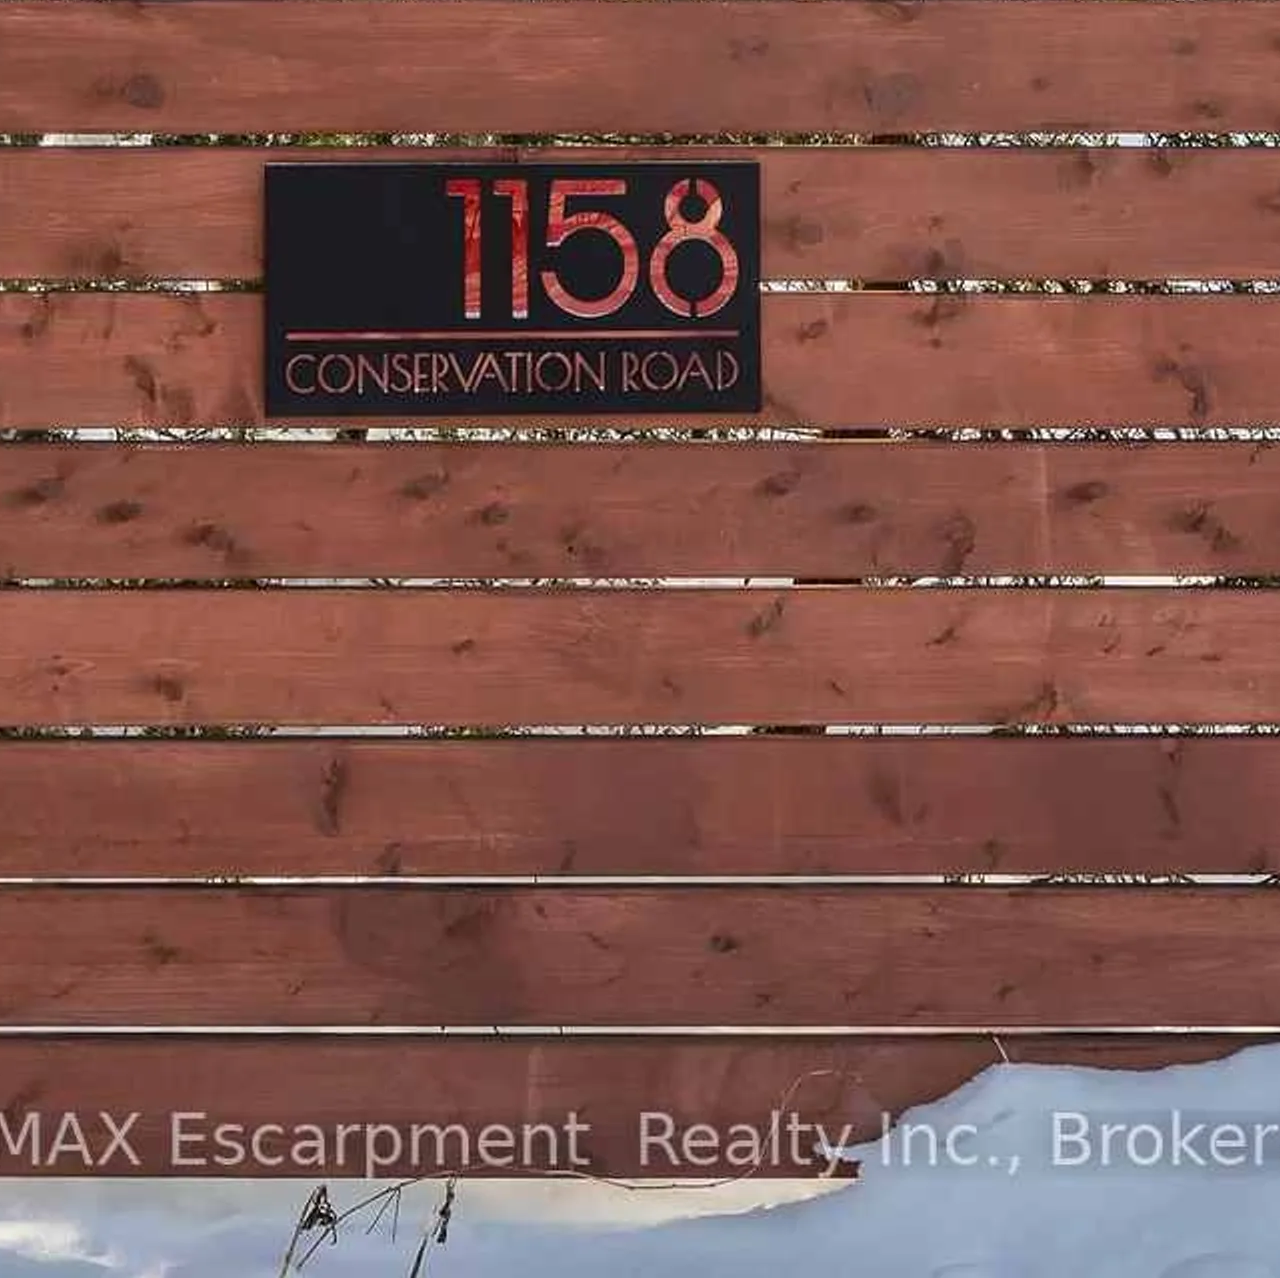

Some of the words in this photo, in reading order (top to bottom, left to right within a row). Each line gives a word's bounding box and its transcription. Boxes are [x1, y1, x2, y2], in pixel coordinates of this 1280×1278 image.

[445, 177, 740, 319] 1158
[284, 351, 606, 395] CONSERVATION
[622, 350, 740, 392] ROAD
